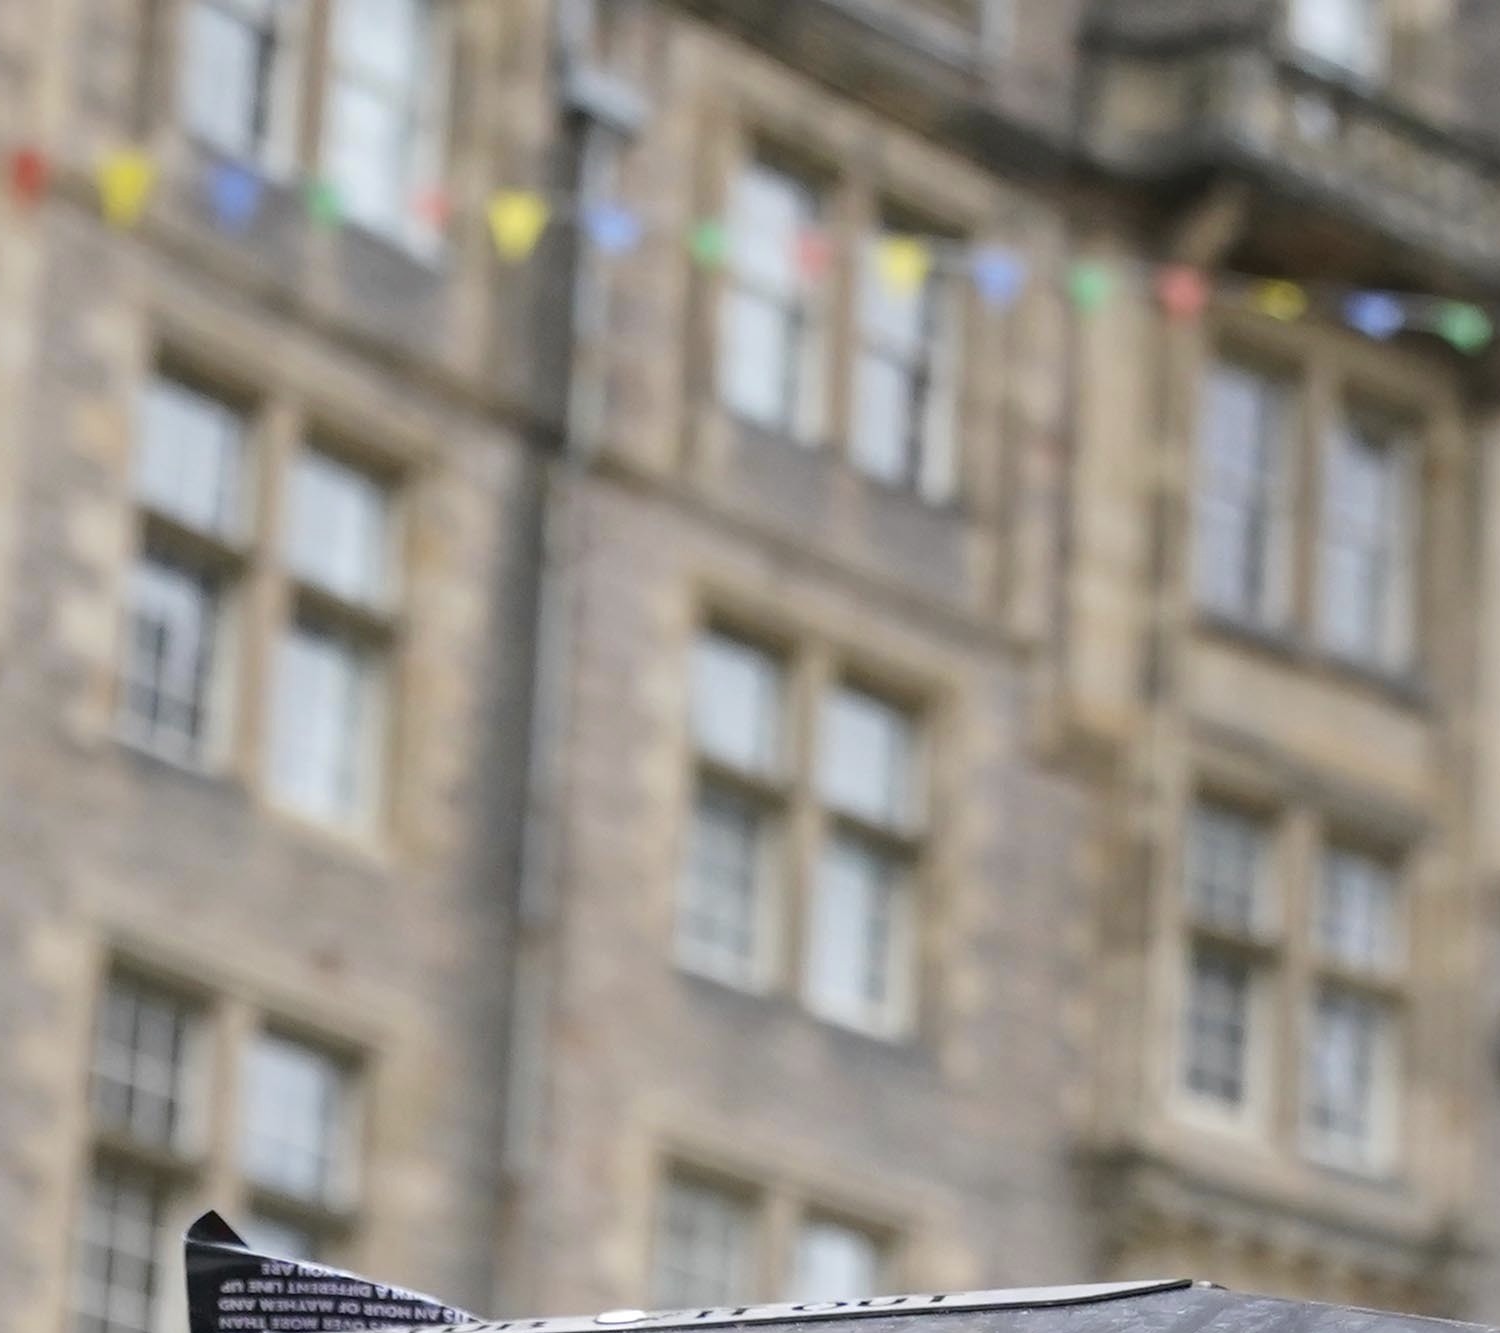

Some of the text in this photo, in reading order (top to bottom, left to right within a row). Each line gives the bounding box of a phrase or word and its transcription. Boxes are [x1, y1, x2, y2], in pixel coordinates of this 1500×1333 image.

[247, 1280, 285, 1294] LINE
[287, 1281, 372, 1297] DIFFERENT
[217, 1299, 257, 1312] AND
[259, 1299, 335, 1314] MAYHEM
[337, 1301, 359, 1316] OF
[363, 1303, 412, 1320] HOUR
